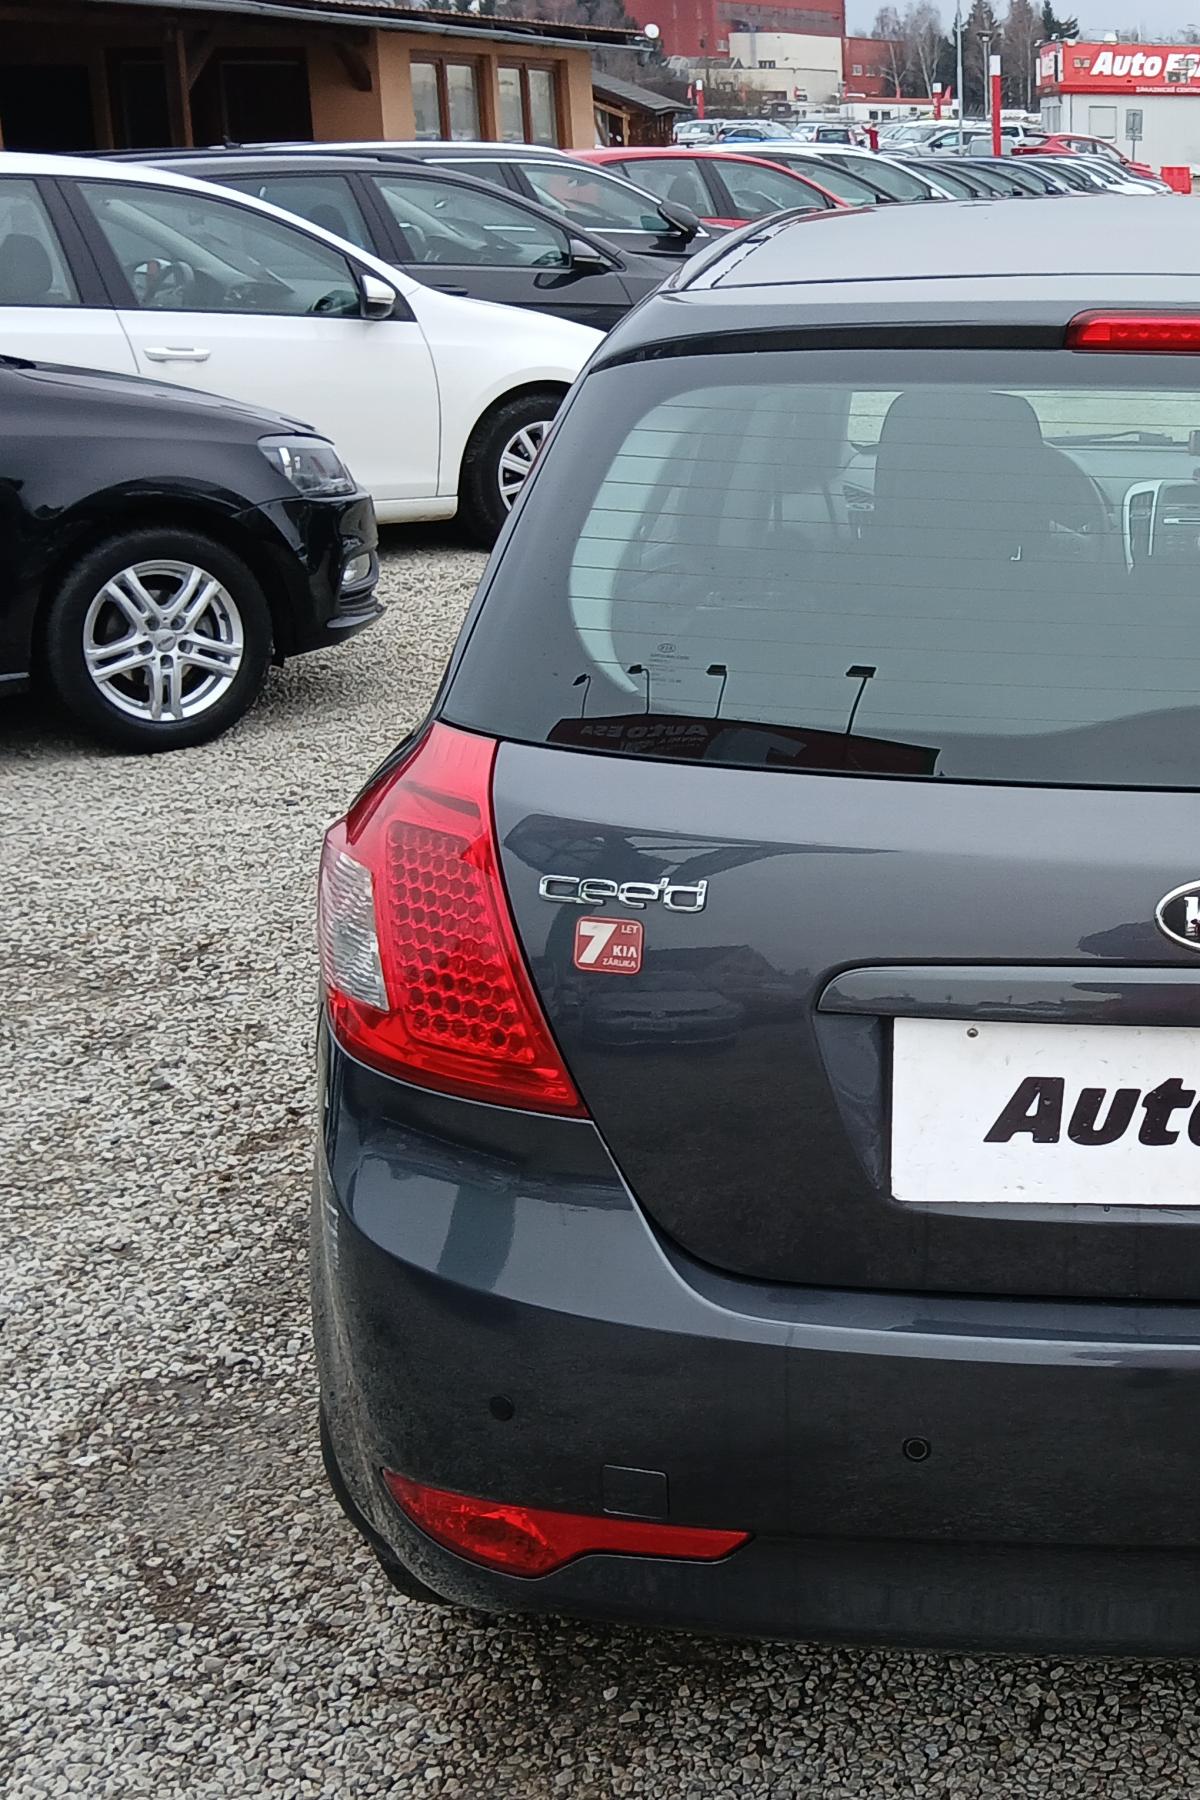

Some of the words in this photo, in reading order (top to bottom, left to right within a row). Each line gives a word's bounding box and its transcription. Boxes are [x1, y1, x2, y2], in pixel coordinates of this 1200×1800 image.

[1090, 51, 1162, 78] Auto
[621, 925, 639, 934] LET
[578, 921, 618, 964] 7
[613, 945, 638, 958] KIA
